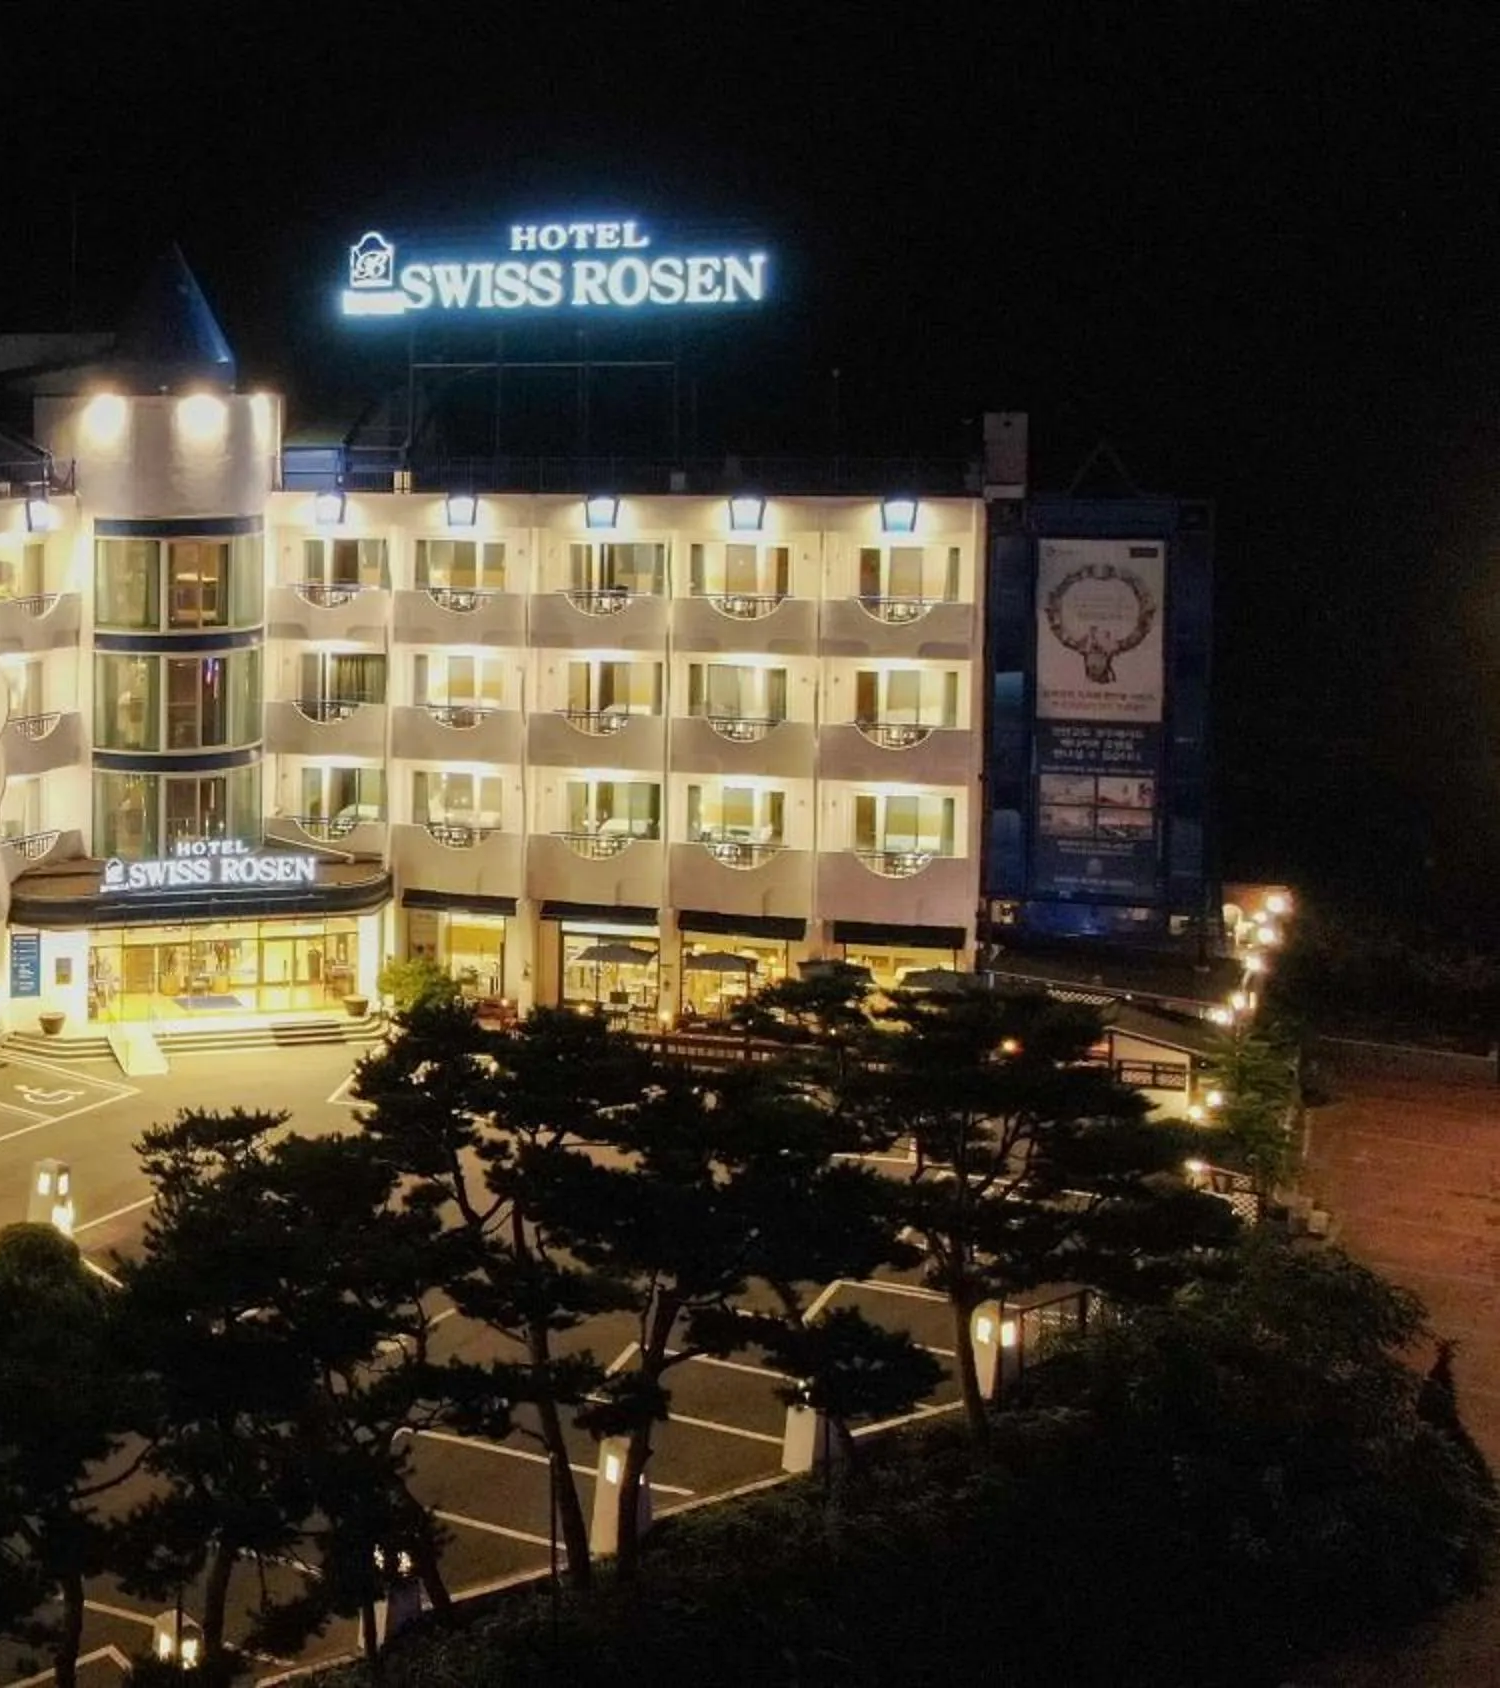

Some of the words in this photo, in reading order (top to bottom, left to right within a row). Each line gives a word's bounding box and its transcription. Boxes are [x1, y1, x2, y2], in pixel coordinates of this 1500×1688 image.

[510, 221, 650, 251] HOTEL
[400, 259, 562, 310] SWISS
[572, 253, 767, 307] ROSEN
[176, 839, 249, 858] HOTEL
[129, 857, 211, 888] SWISS
[220, 855, 316, 883] ROSEN
